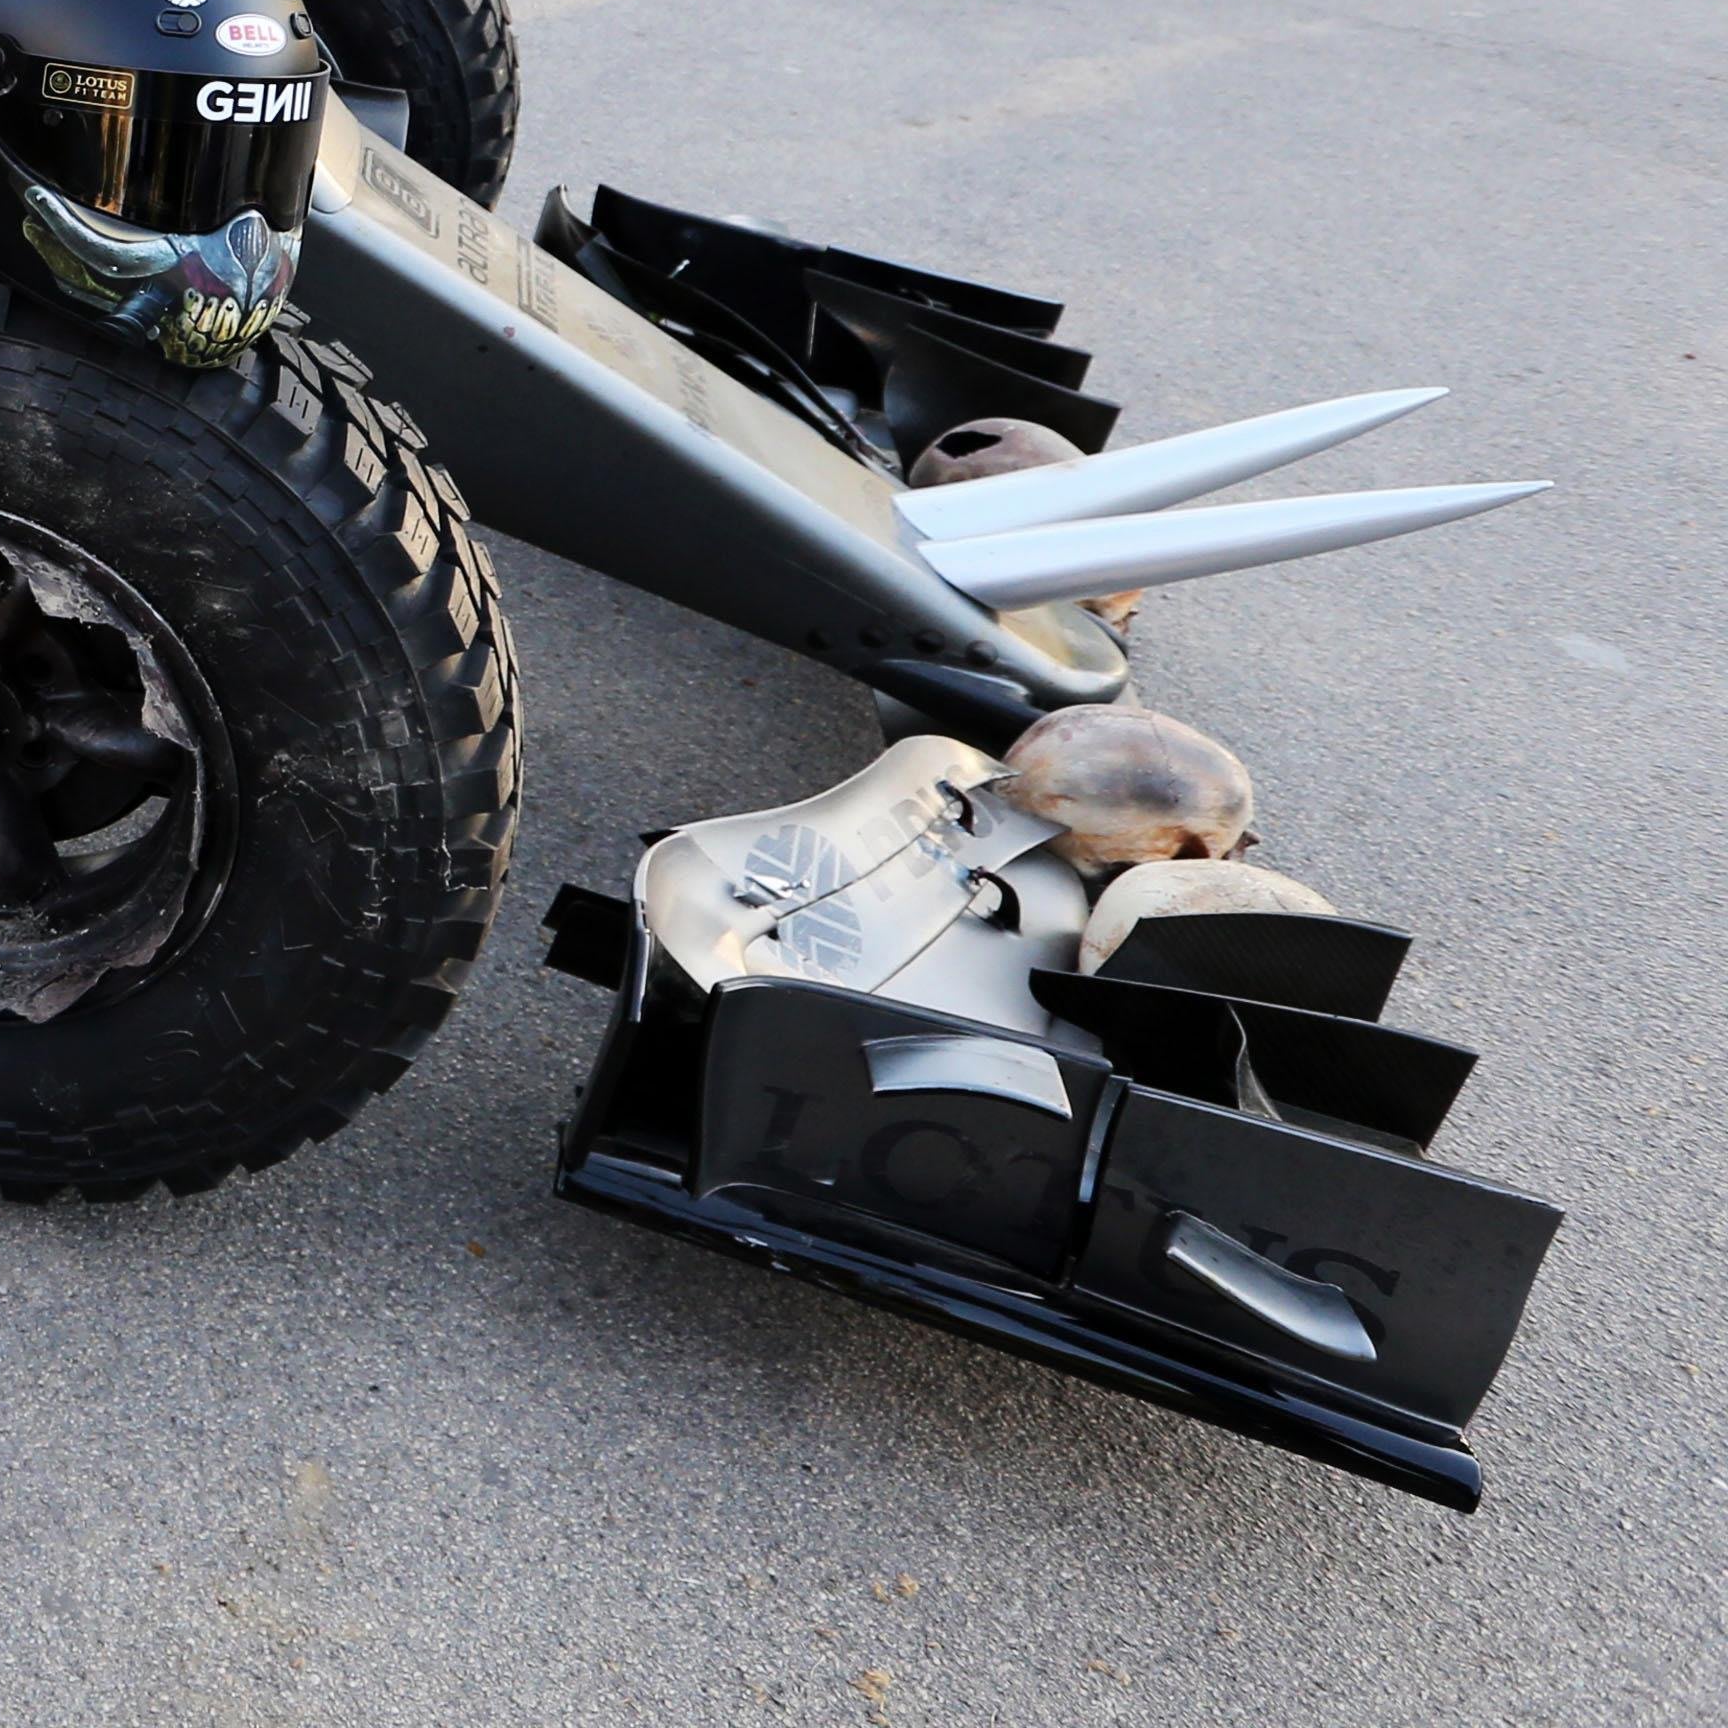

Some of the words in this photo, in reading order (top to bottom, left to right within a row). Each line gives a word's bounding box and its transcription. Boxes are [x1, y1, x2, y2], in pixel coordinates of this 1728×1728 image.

[228, 24, 279, 42] BELL
[75, 74, 128, 92] LOTUS
[74, 86, 87, 96] F1
[93, 88, 127, 101] TEAM
